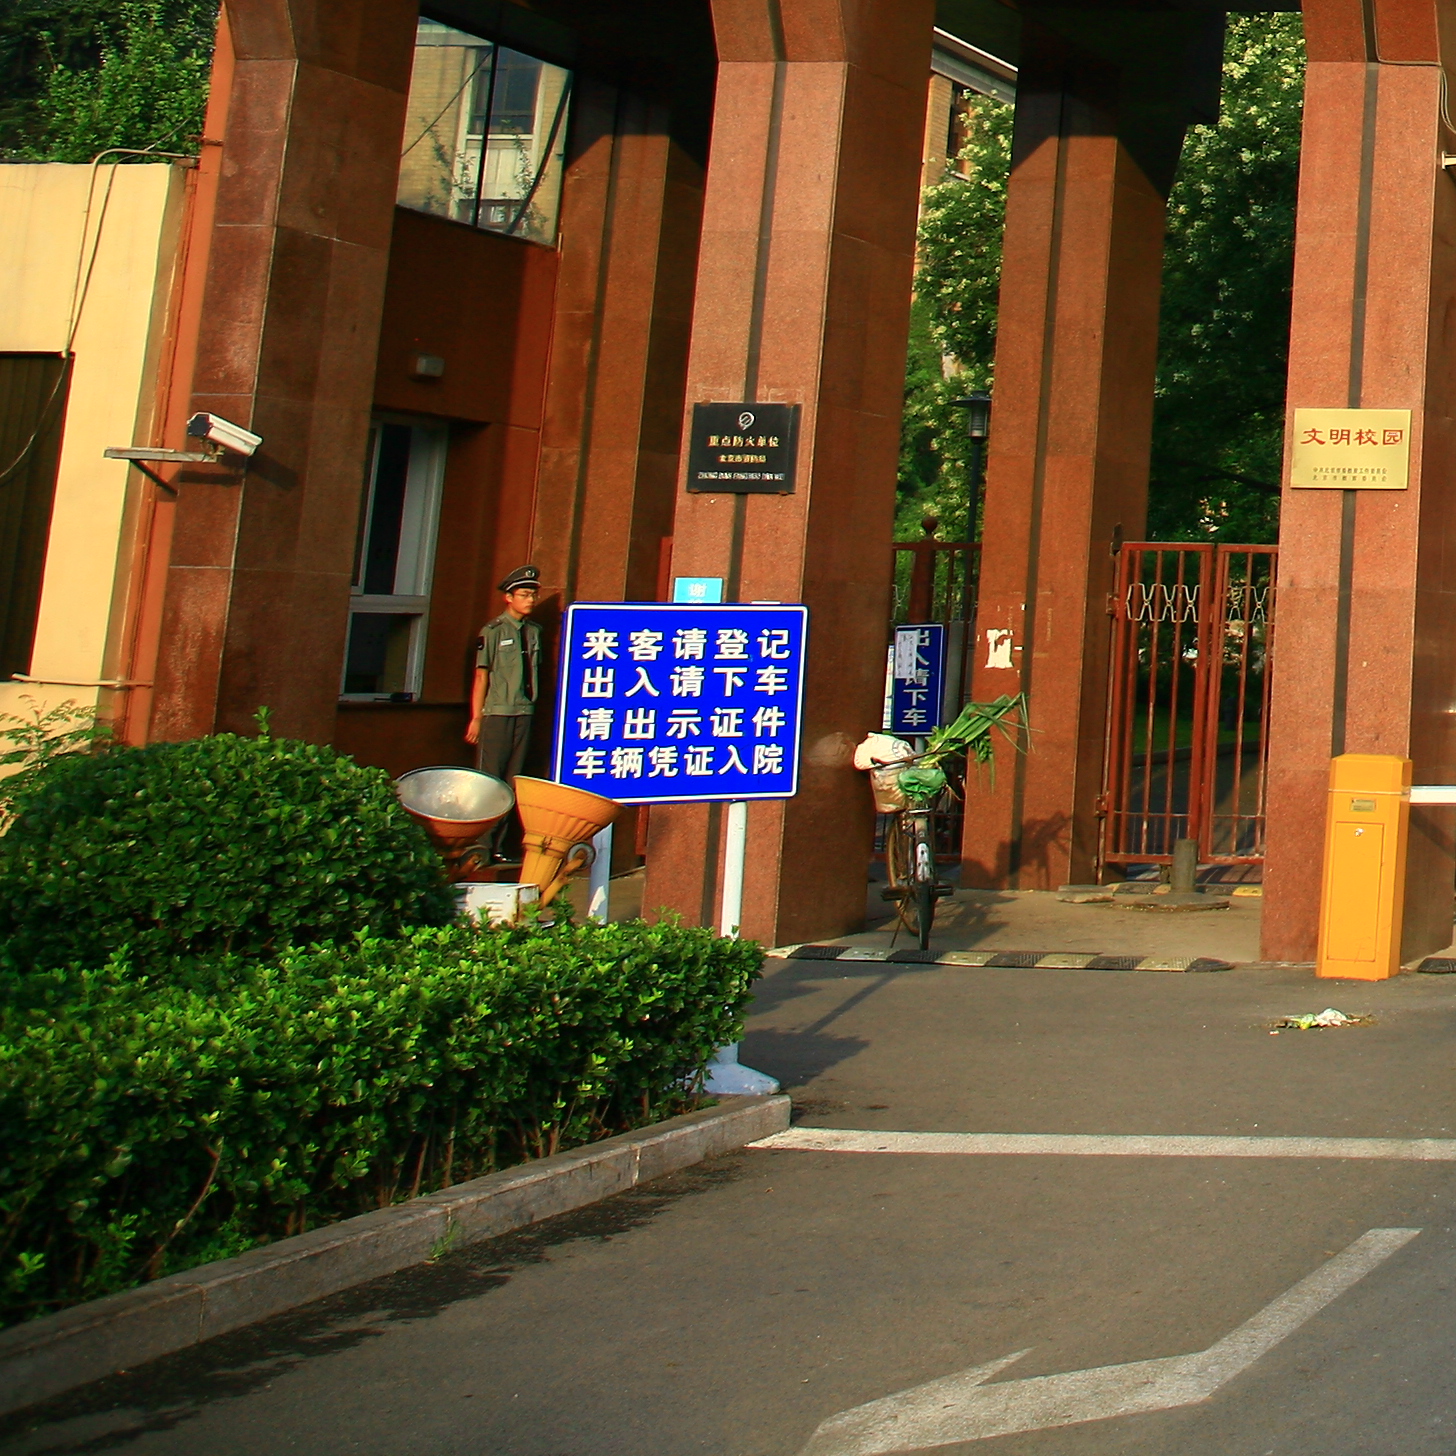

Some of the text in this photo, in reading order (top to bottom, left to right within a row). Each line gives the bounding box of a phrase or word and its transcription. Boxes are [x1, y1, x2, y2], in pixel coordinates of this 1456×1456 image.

[708, 435, 780, 448] 重点防火单位
[1301, 428, 1404, 446] 文明校园
[582, 628, 791, 661] 来客请登记
[581, 665, 789, 698] 出入请下车
[576, 706, 787, 740] 请出示证件
[573, 744, 784, 779] 车辆凭证入院
